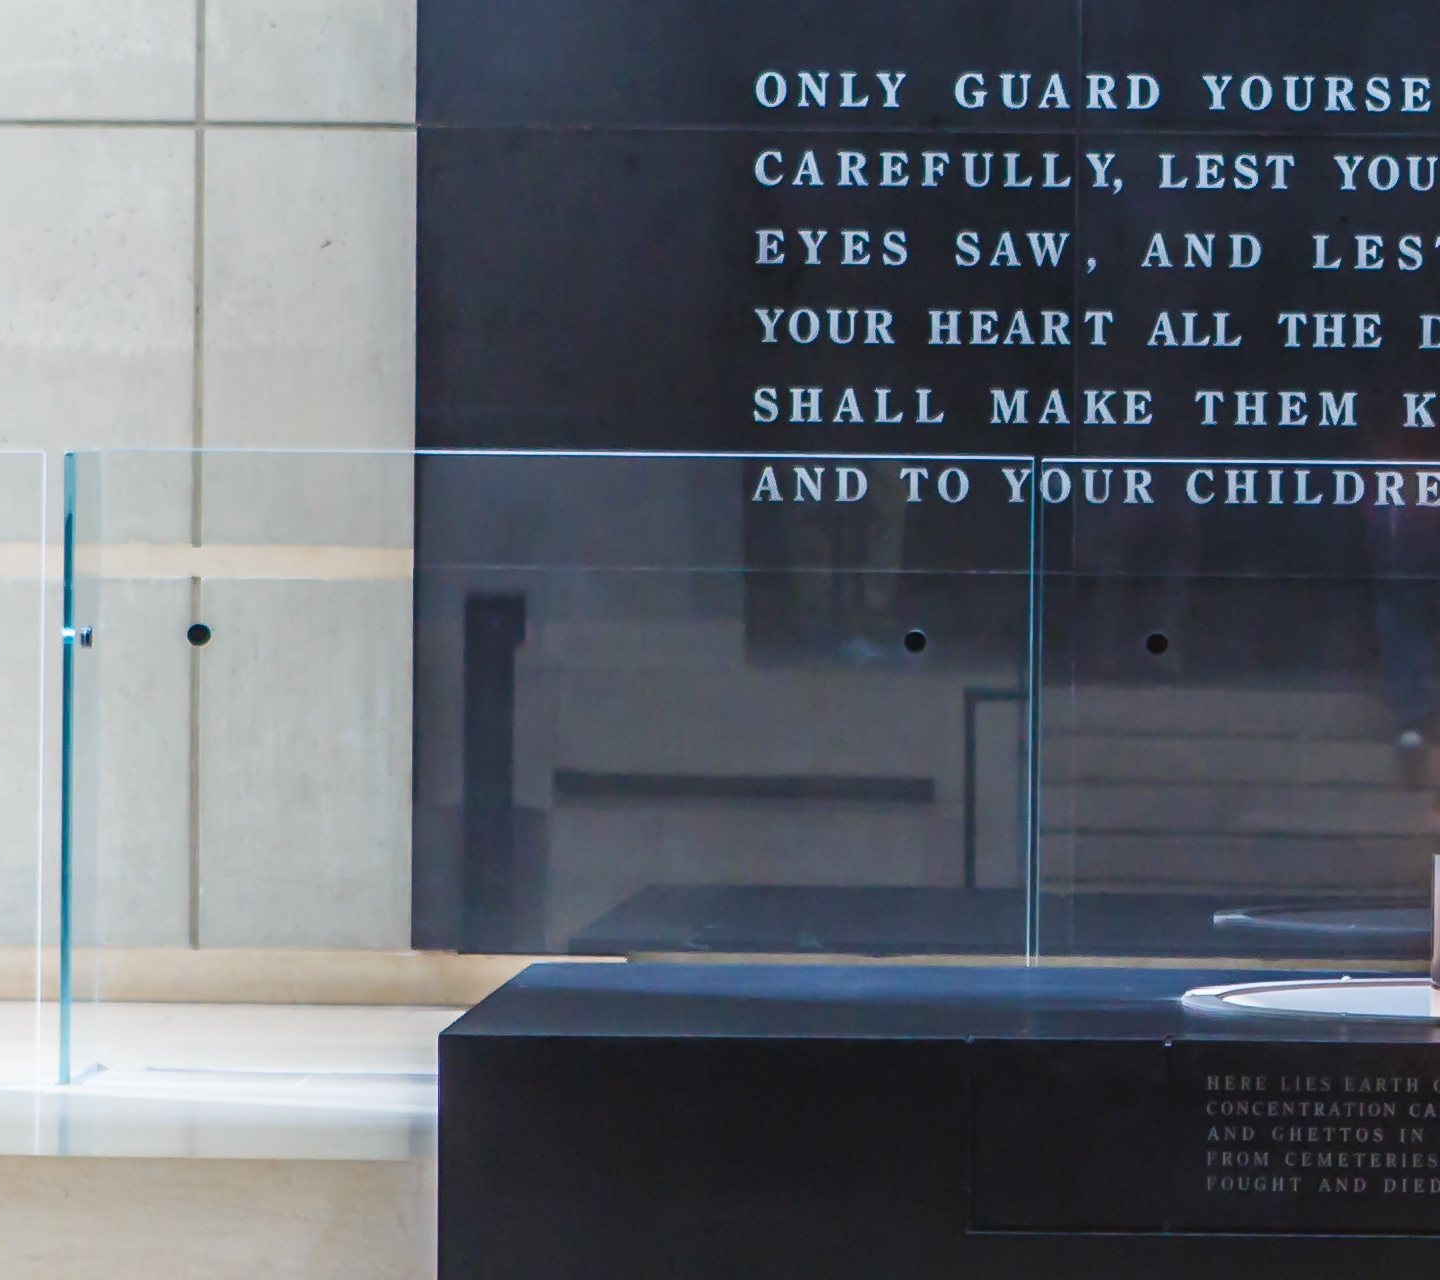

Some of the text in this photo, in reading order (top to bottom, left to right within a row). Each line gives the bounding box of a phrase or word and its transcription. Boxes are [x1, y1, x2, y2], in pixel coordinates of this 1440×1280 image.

[754, 69, 907, 110] ONLY
[954, 70, 1160, 112] GUARD
[754, 148, 1123, 196] CAREFULLY,
[1158, 151, 1295, 191] LEST
[1333, 153, 1439, 193] YOU
[755, 228, 908, 267] EYES
[1140, 231, 1262, 269] AND
[754, 306, 895, 345] YOUR
[928, 307, 1114, 348] HEART
[1147, 310, 1243, 348] ALL
[1277, 311, 1383, 349] THE
[752, 385, 945, 426] SHALL
[990, 386, 1153, 426] MAKE
[1194, 388, 1358, 428] THEM
[752, 465, 868, 503] AND
[899, 466, 970, 504] TO
[1001, 467, 1154, 506] YOUR
[1206, 1074, 1266, 1092] HERE
[1280, 1075, 1331, 1093] LIES
[1344, 1075, 1418, 1094] EARTH
[1205, 1099, 1396, 1119] CONCENTRATION
[1206, 1124, 1255, 1143] AND
[1271, 1124, 1384, 1145] GHETTOS
[1399, 1127, 1424, 1145] IN
[1206, 1150, 1269, 1168] FROM
[1283, 1151, 1438, 1170] CEMETERIES
[1206, 1175, 1302, 1193] FOUGHT
[1318, 1176, 1367, 1194] AND
